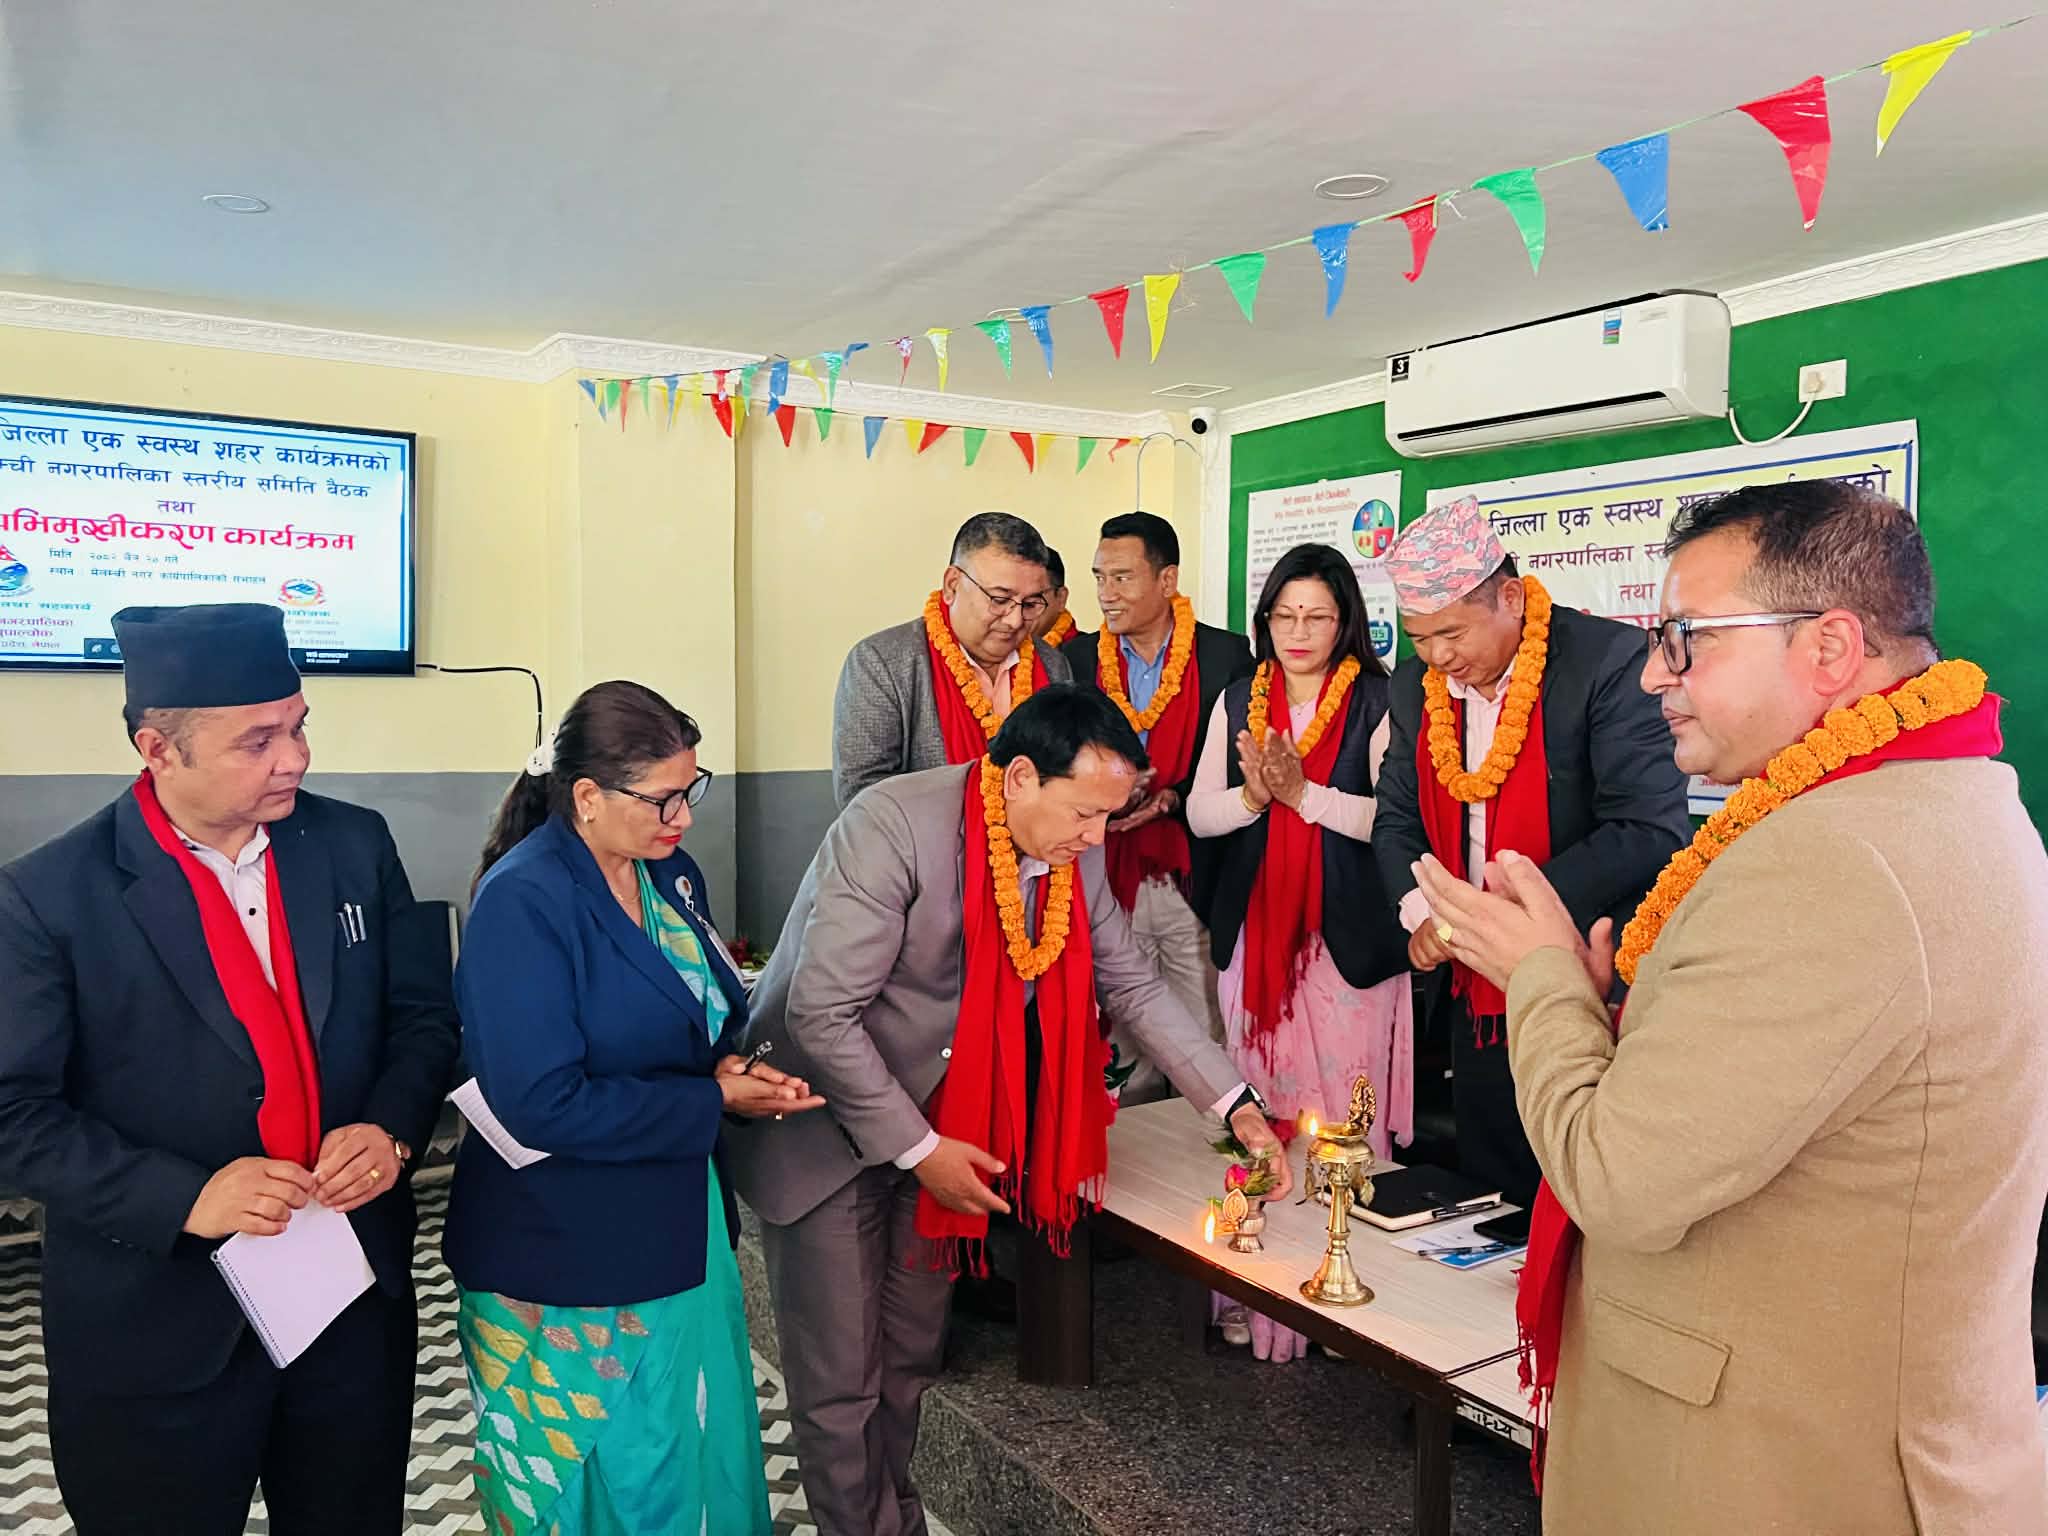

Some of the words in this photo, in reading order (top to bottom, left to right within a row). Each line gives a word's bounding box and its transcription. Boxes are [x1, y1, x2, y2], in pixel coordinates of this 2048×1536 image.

[82, 431, 124, 452] एक
[136, 435, 200, 456] स्वस्थ
[213, 442, 264, 464] शहर
[275, 445, 390, 472] कार्यक्रमको
[48, 462, 172, 482] नगरपालिका
[183, 471, 246, 490] स्तरीय
[256, 474, 317, 495] समिति
[156, 500, 196, 515] तथा
[1488, 510, 1547, 536] जिल्ला
[1558, 507, 1593, 535] एक
[1604, 498, 1663, 526] स्वस्थ
[223, 524, 357, 551] कार्यक्रम
[1528, 542, 1634, 570] नगरपालिका
[1619, 583, 1656, 602] तथा
